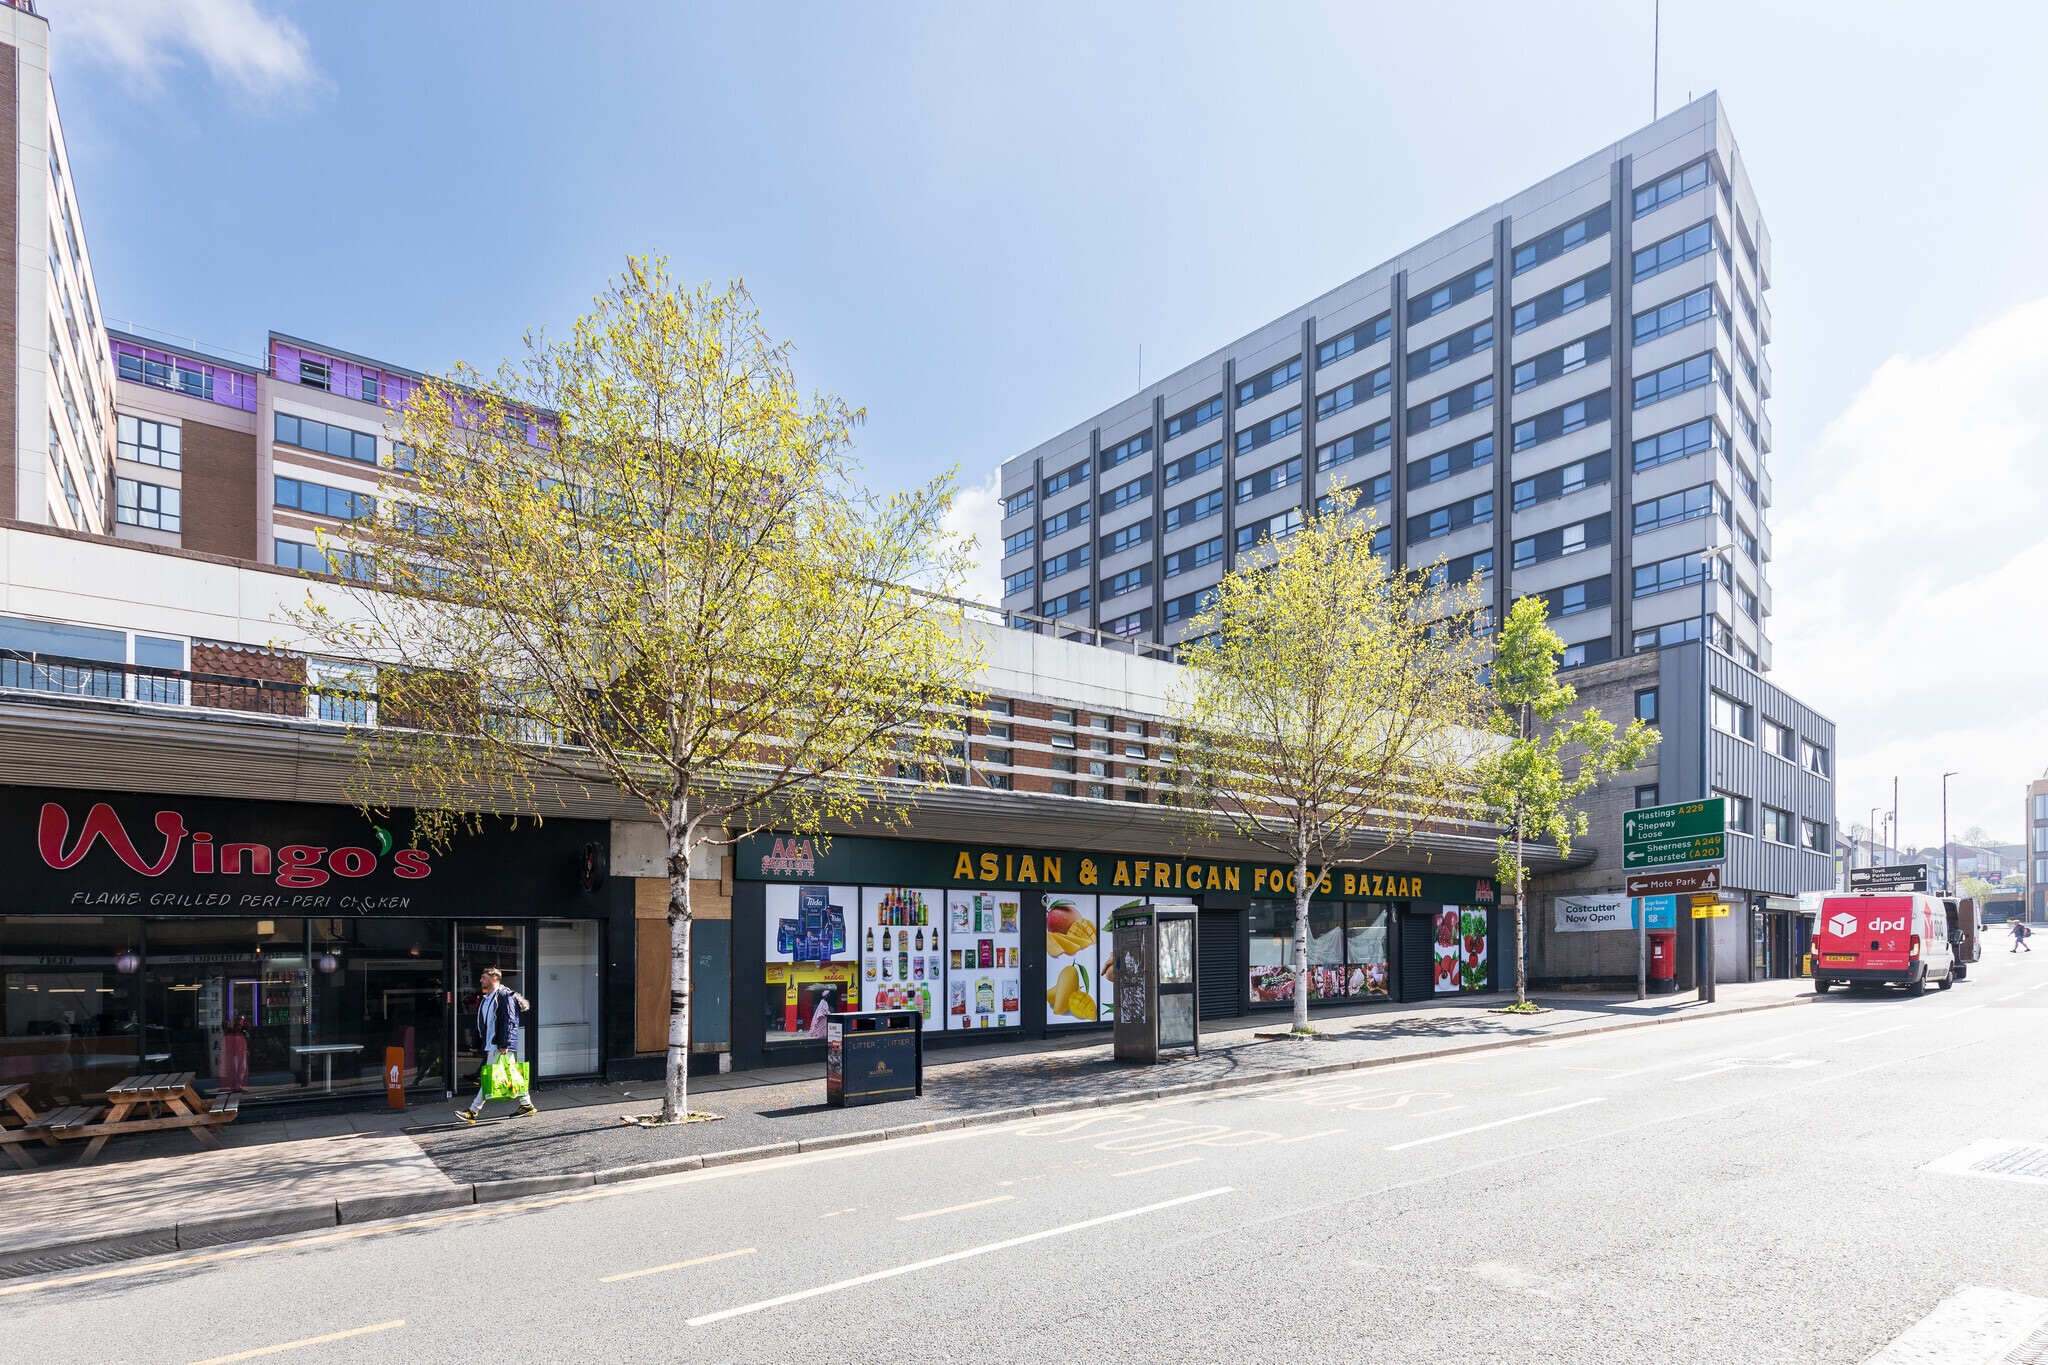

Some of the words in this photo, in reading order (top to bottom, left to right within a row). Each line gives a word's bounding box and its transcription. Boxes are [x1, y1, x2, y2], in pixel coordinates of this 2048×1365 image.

[1638, 808, 1676, 821] Hastings
[1678, 803, 1704, 815] A229
[1638, 820, 1676, 831] Shepway
[1638, 831, 1663, 840] Loose
[38, 802, 432, 889] Wingo's
[771, 838, 814, 860] A&A
[1646, 841, 1692, 852] Sheerness
[1694, 836, 1721, 846] A249
[1647, 851, 1687, 863] Bearsted
[1689, 847, 1720, 859] (A20)
[953, 851, 1062, 884] ASIAN
[1079, 858, 1098, 886] &
[1112, 860, 1240, 892] AFRICAN
[1344, 873, 1422, 898] BAZAAR
[1650, 880, 1674, 889] Mote
[1676, 878, 1697, 887] Park
[70, 892, 141, 905] FLAME
[149, 893, 231, 907] GRILLED
[239, 894, 331, 907] PERI-PERI
[805, 896, 823, 906] Tilda
[1565, 904, 1617, 914] Costcutter
[1565, 914, 1588, 923] Now
[1589, 914, 1616, 924] Open
[1868, 917, 1905, 934] dpd
[852, 1041, 876, 1049] LITTER
